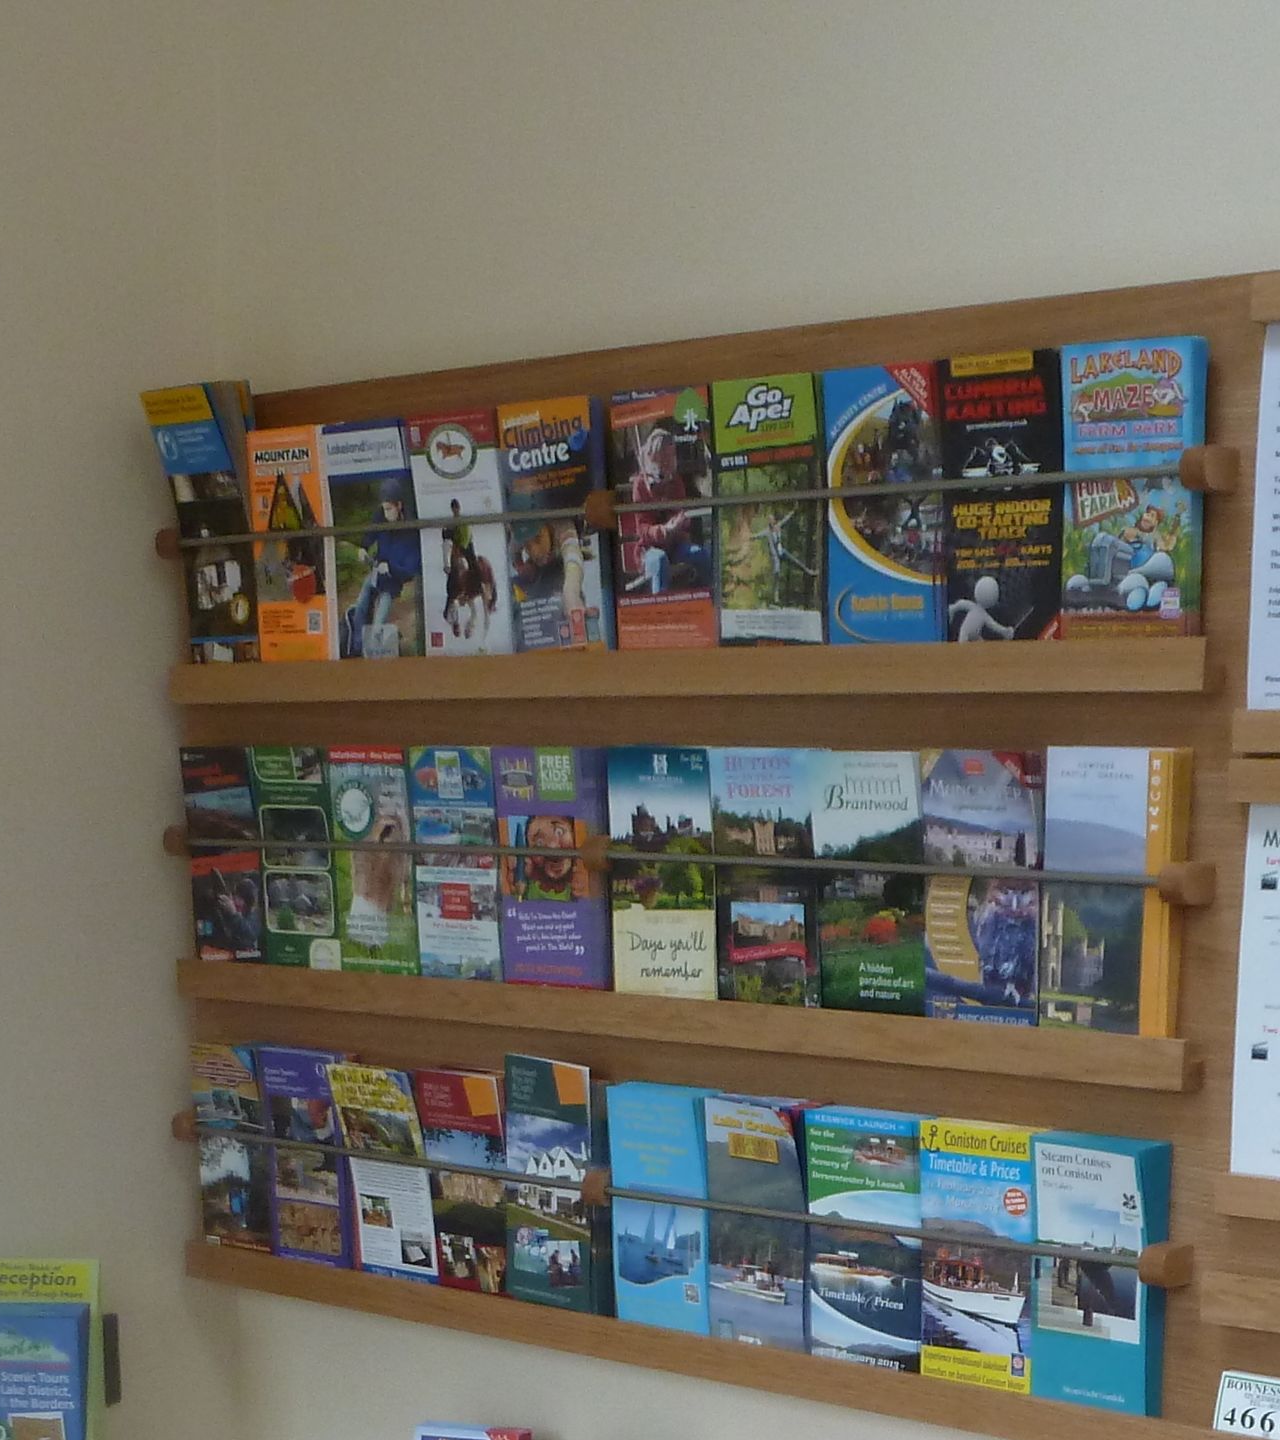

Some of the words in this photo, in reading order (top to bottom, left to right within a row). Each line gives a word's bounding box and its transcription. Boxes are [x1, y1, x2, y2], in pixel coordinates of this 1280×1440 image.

[1071, 348, 1182, 384] LAKELAND
[746, 383, 784, 407] Go
[1093, 384, 1155, 411] MAZE
[725, 395, 795, 432] Ape!
[945, 398, 1048, 420] KARTING
[504, 415, 584, 448] Climbing
[1079, 422, 1127, 437] FARM
[1132, 420, 1178, 434] PARK
[255, 448, 309, 463] MOUNTAIN
[509, 442, 570, 472] Centre
[952, 502, 994, 517] HUGE
[995, 498, 1052, 515] INDOOR
[1080, 494, 1119, 519] FARM
[956, 511, 1049, 529] GO-KARTING
[978, 526, 1028, 540] TRACK
[1020, 544, 1053, 555] KARTS
[540, 755, 570, 769] FREE
[727, 782, 793, 799] FOREST
[824, 783, 908, 811] Brantwood
[626, 931, 667, 961] Days
[669, 930, 707, 961] you'll
[640, 962, 704, 981] remember
[859, 962, 866, 972] A
[866, 963, 894, 974] hidden
[859, 975, 892, 987] paradise
[892, 977, 901, 988] of
[901, 978, 914, 989] art
[860, 989, 875, 999] and
[875, 990, 901, 1000] nature
[1263, 1025, 1278, 1034] Two
[815, 1114, 855, 1127] KESWICK
[858, 1119, 896, 1130] LAUNCH
[809, 1127, 821, 1137] See
[823, 1129, 835, 1138] the
[944, 1130, 987, 1150] Coniston
[990, 1135, 1027, 1155] Cruises
[811, 1157, 840, 1169] Scenery
[929, 1153, 977, 1175] Timetable
[979, 1160, 987, 1176] &
[990, 1160, 1020, 1181] Prices
[1040, 1149, 1073, 1164] Steam
[1075, 1153, 1111, 1169] Cruises
[1041, 1166, 1055, 1175] on
[1056, 1165, 1103, 1181] Coniston
[865, 1177, 875, 1188] by
[876, 1179, 905, 1190] Launch
[819, 1287, 866, 1304] Timetable
[874, 1296, 904, 1311] Prices
[0, 1371, 36, 1383] Scenic
[37, 1372, 70, 1384] Tours
[0, 1383, 26, 1395] Lake
[27, 1385, 72, 1397] District,
[10, 1397, 28, 1408] the
[30, 1398, 75, 1409] Borders
